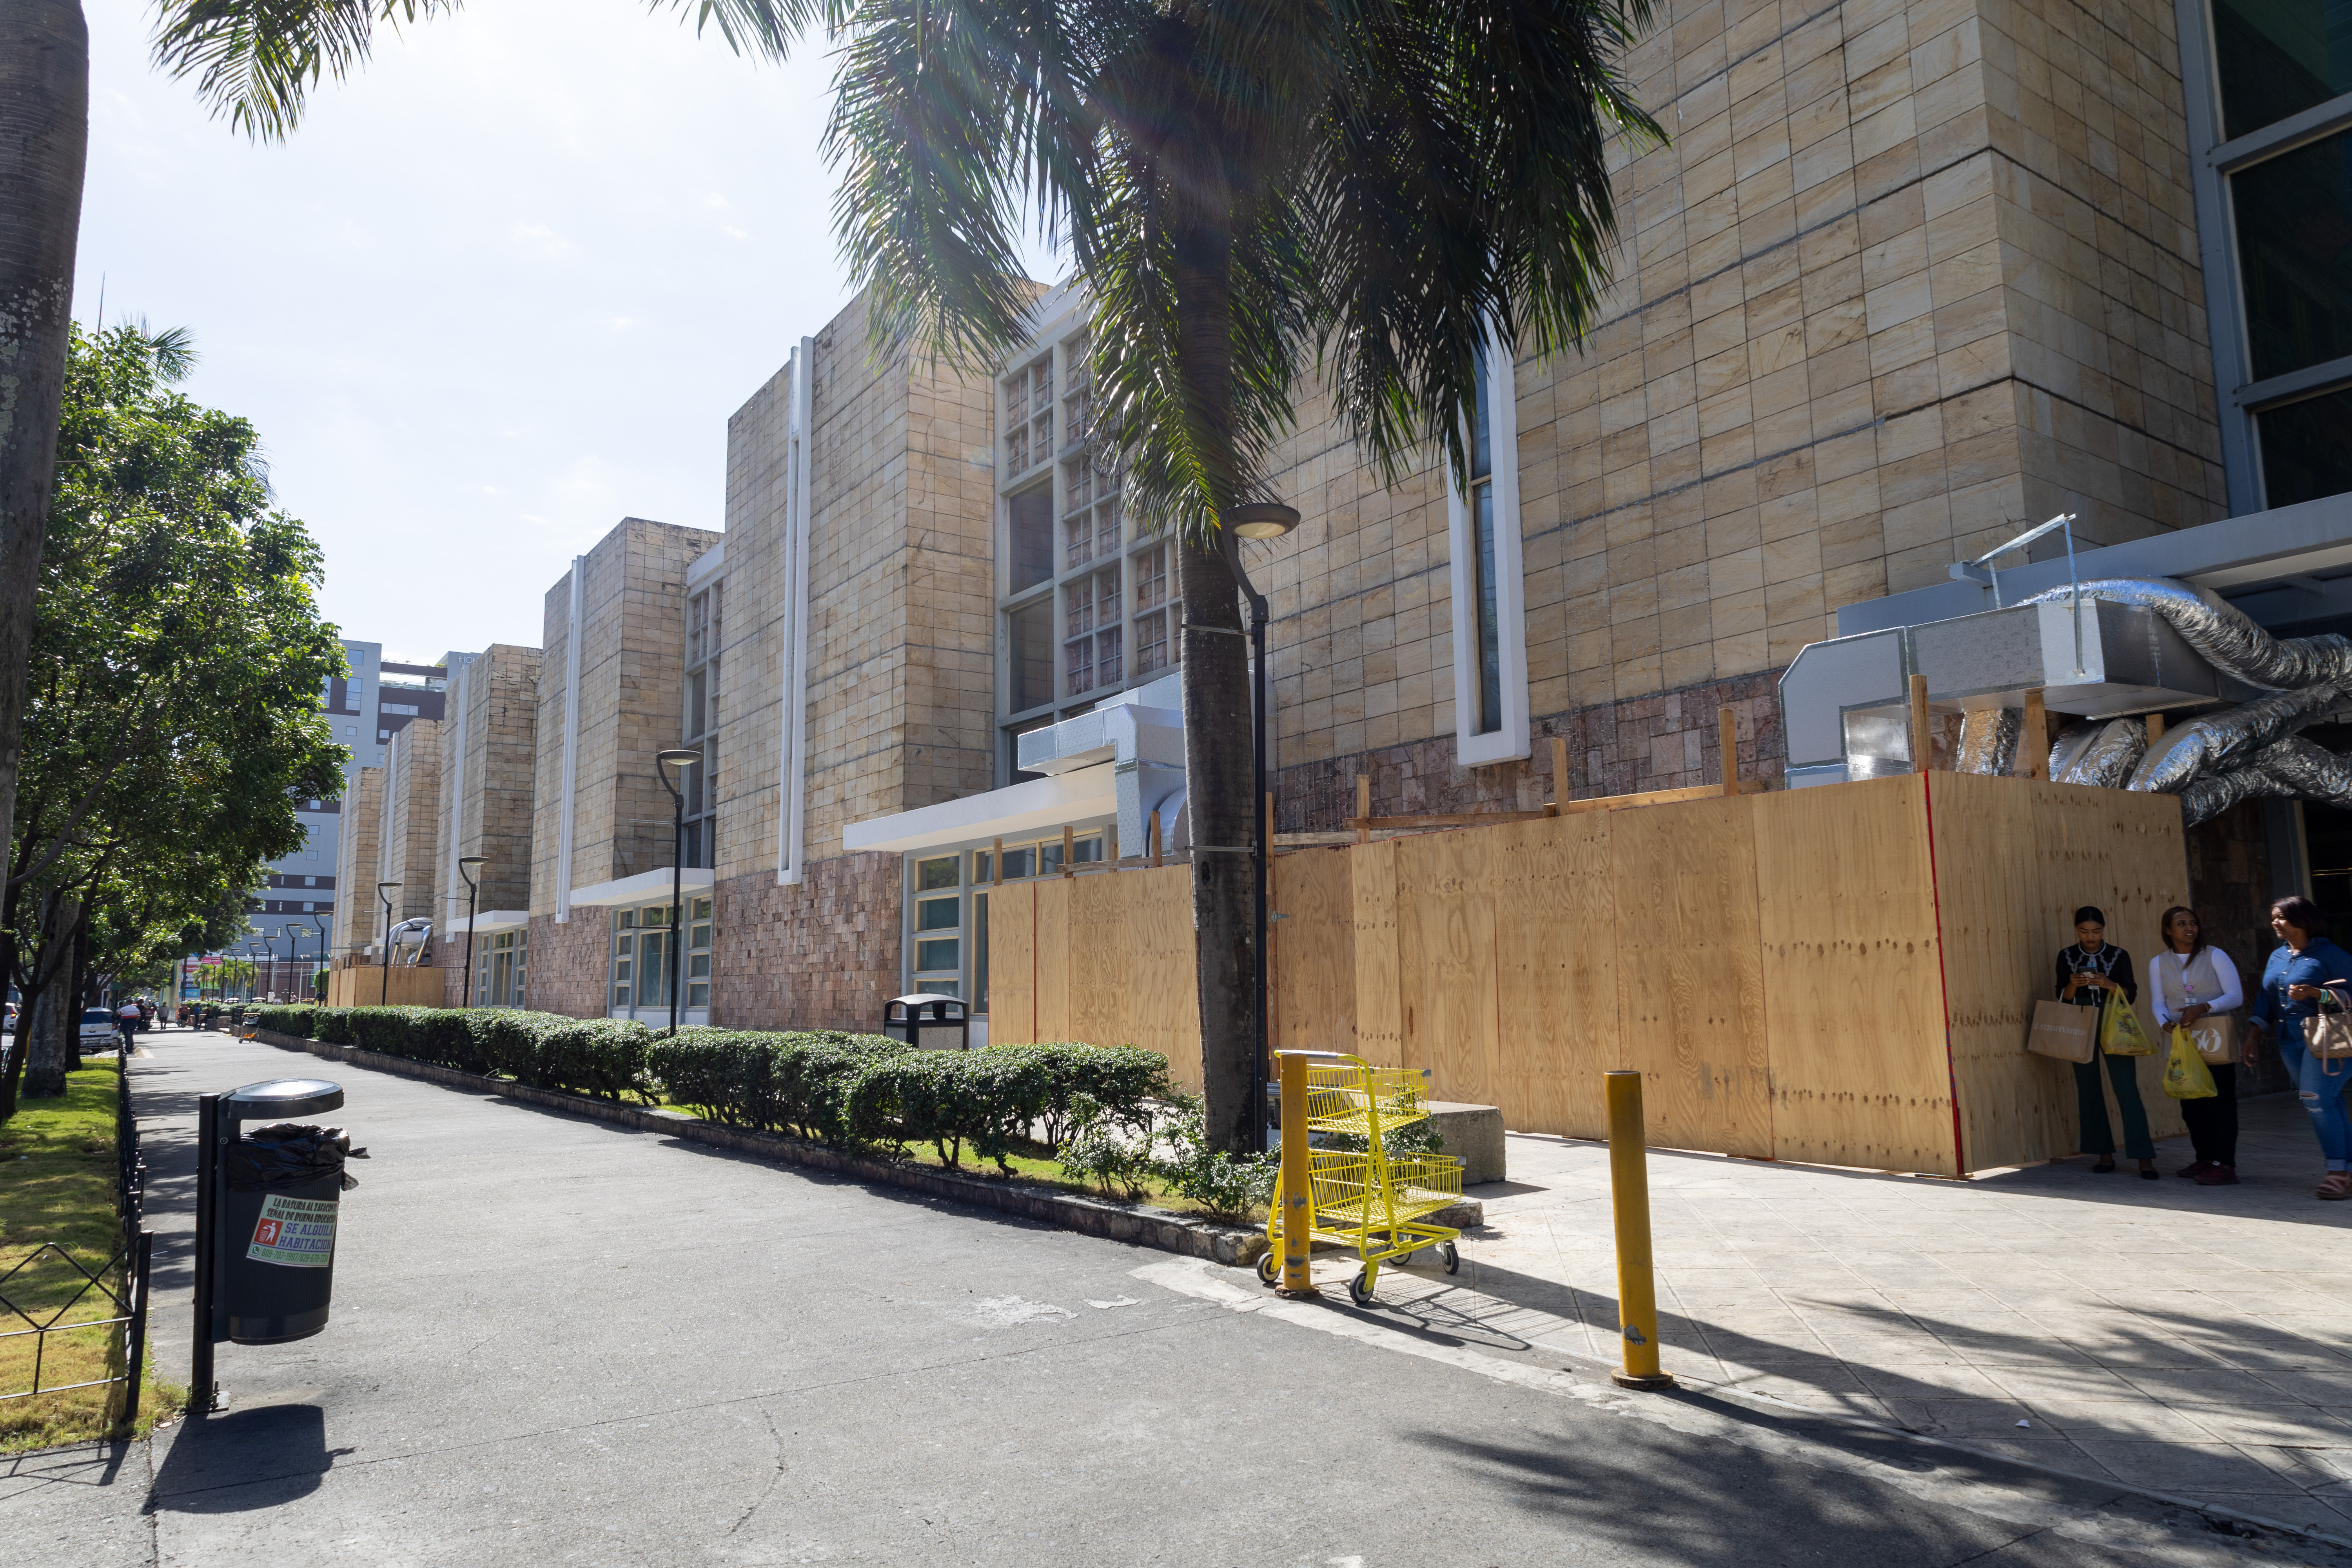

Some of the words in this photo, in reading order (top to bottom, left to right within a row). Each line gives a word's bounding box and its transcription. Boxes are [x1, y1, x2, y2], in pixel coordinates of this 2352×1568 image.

[2040, 1024, 2086, 1036] STRADIVARIUS
[273, 1198, 281, 1207] LA
[281, 1199, 306, 1210] BASURA
[306, 1202, 314, 1211] AL
[314, 1203, 333, 1212] ZAFACON
[267, 1207, 285, 1219] SEÑAL
[285, 1211, 295, 1220] DE
[294, 1212, 314, 1222] BUENA
[285, 1223, 299, 1234] SE
[300, 1224, 333, 1236] ALQUILA
[278, 1236, 332, 1250] HABITACION
